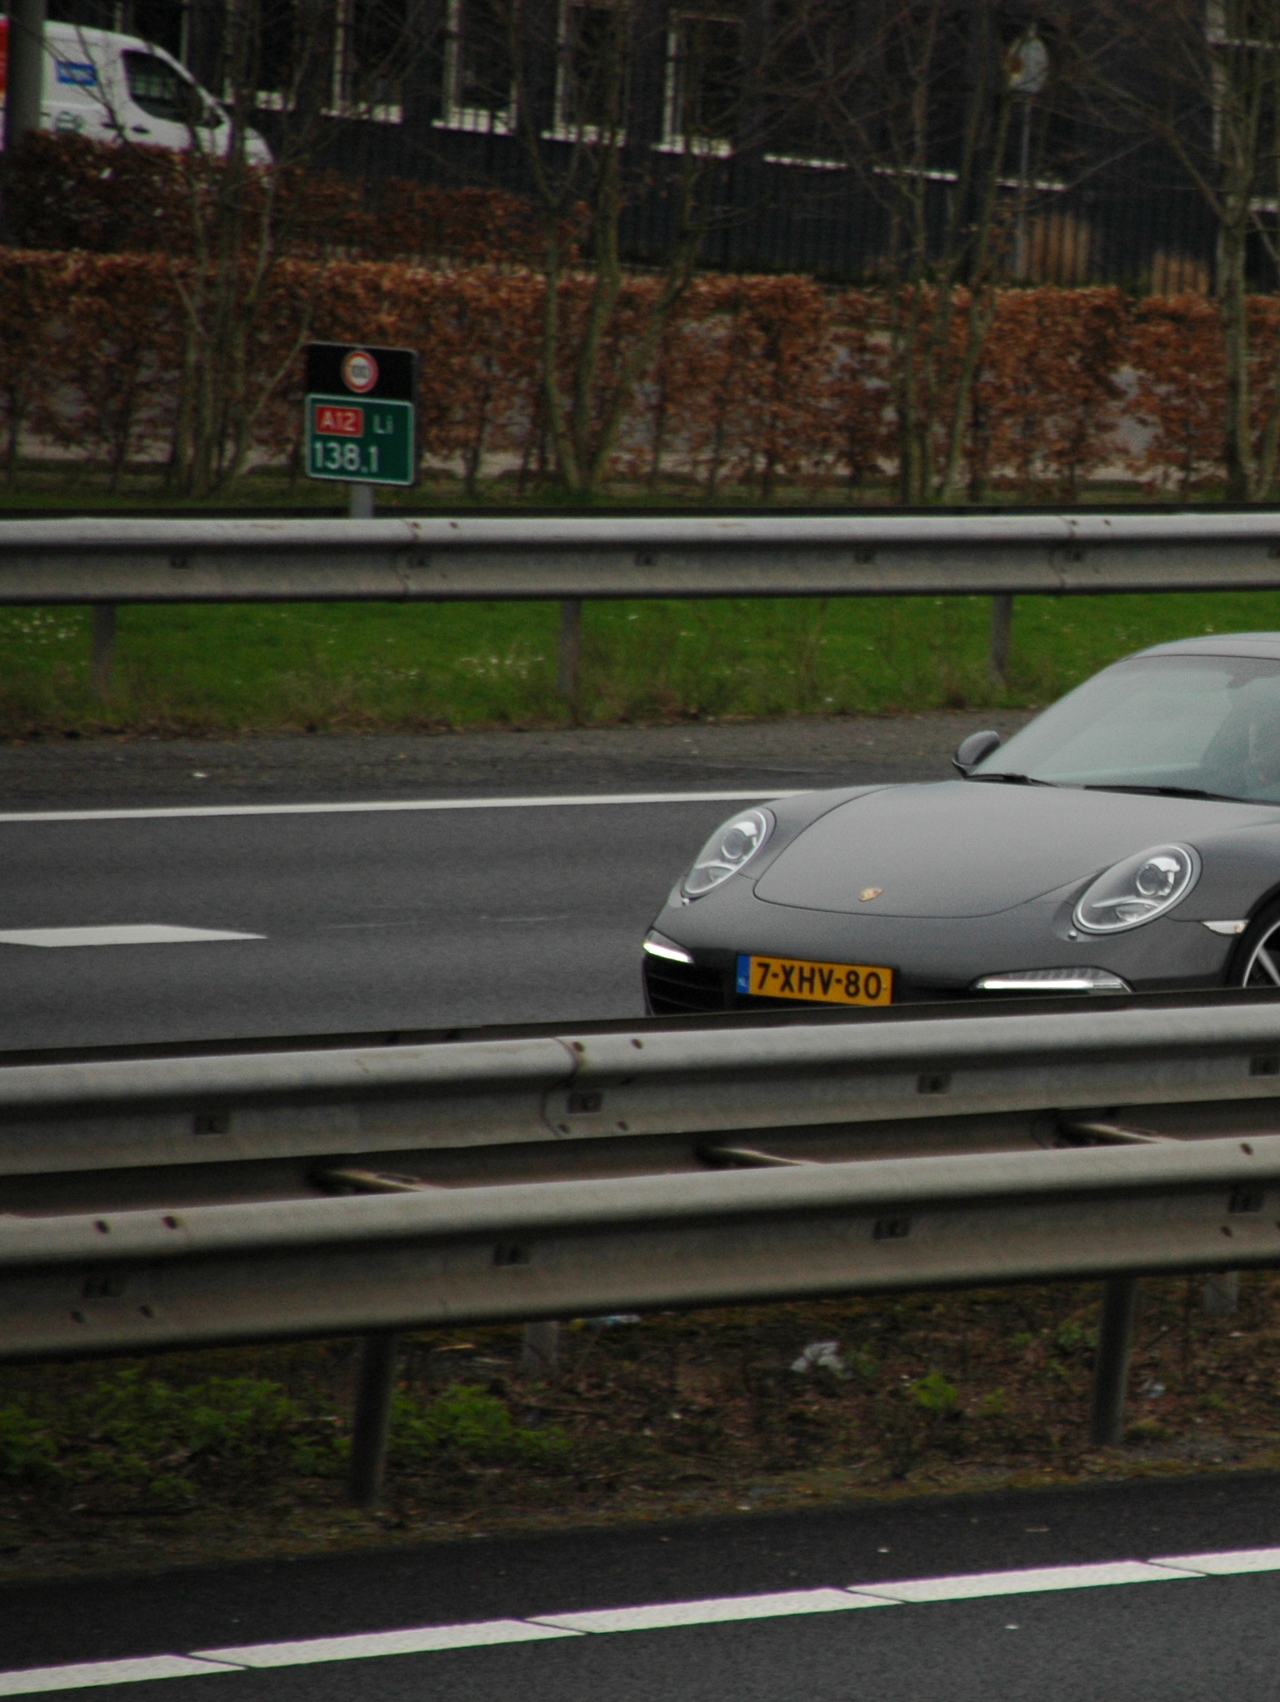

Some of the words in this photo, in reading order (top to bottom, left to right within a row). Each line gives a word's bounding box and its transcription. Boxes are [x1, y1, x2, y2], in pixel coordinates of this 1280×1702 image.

[320, 411, 357, 432] A12
[314, 441, 379, 473] 138.1
[757, 962, 882, 1000] 7-XHV-80
